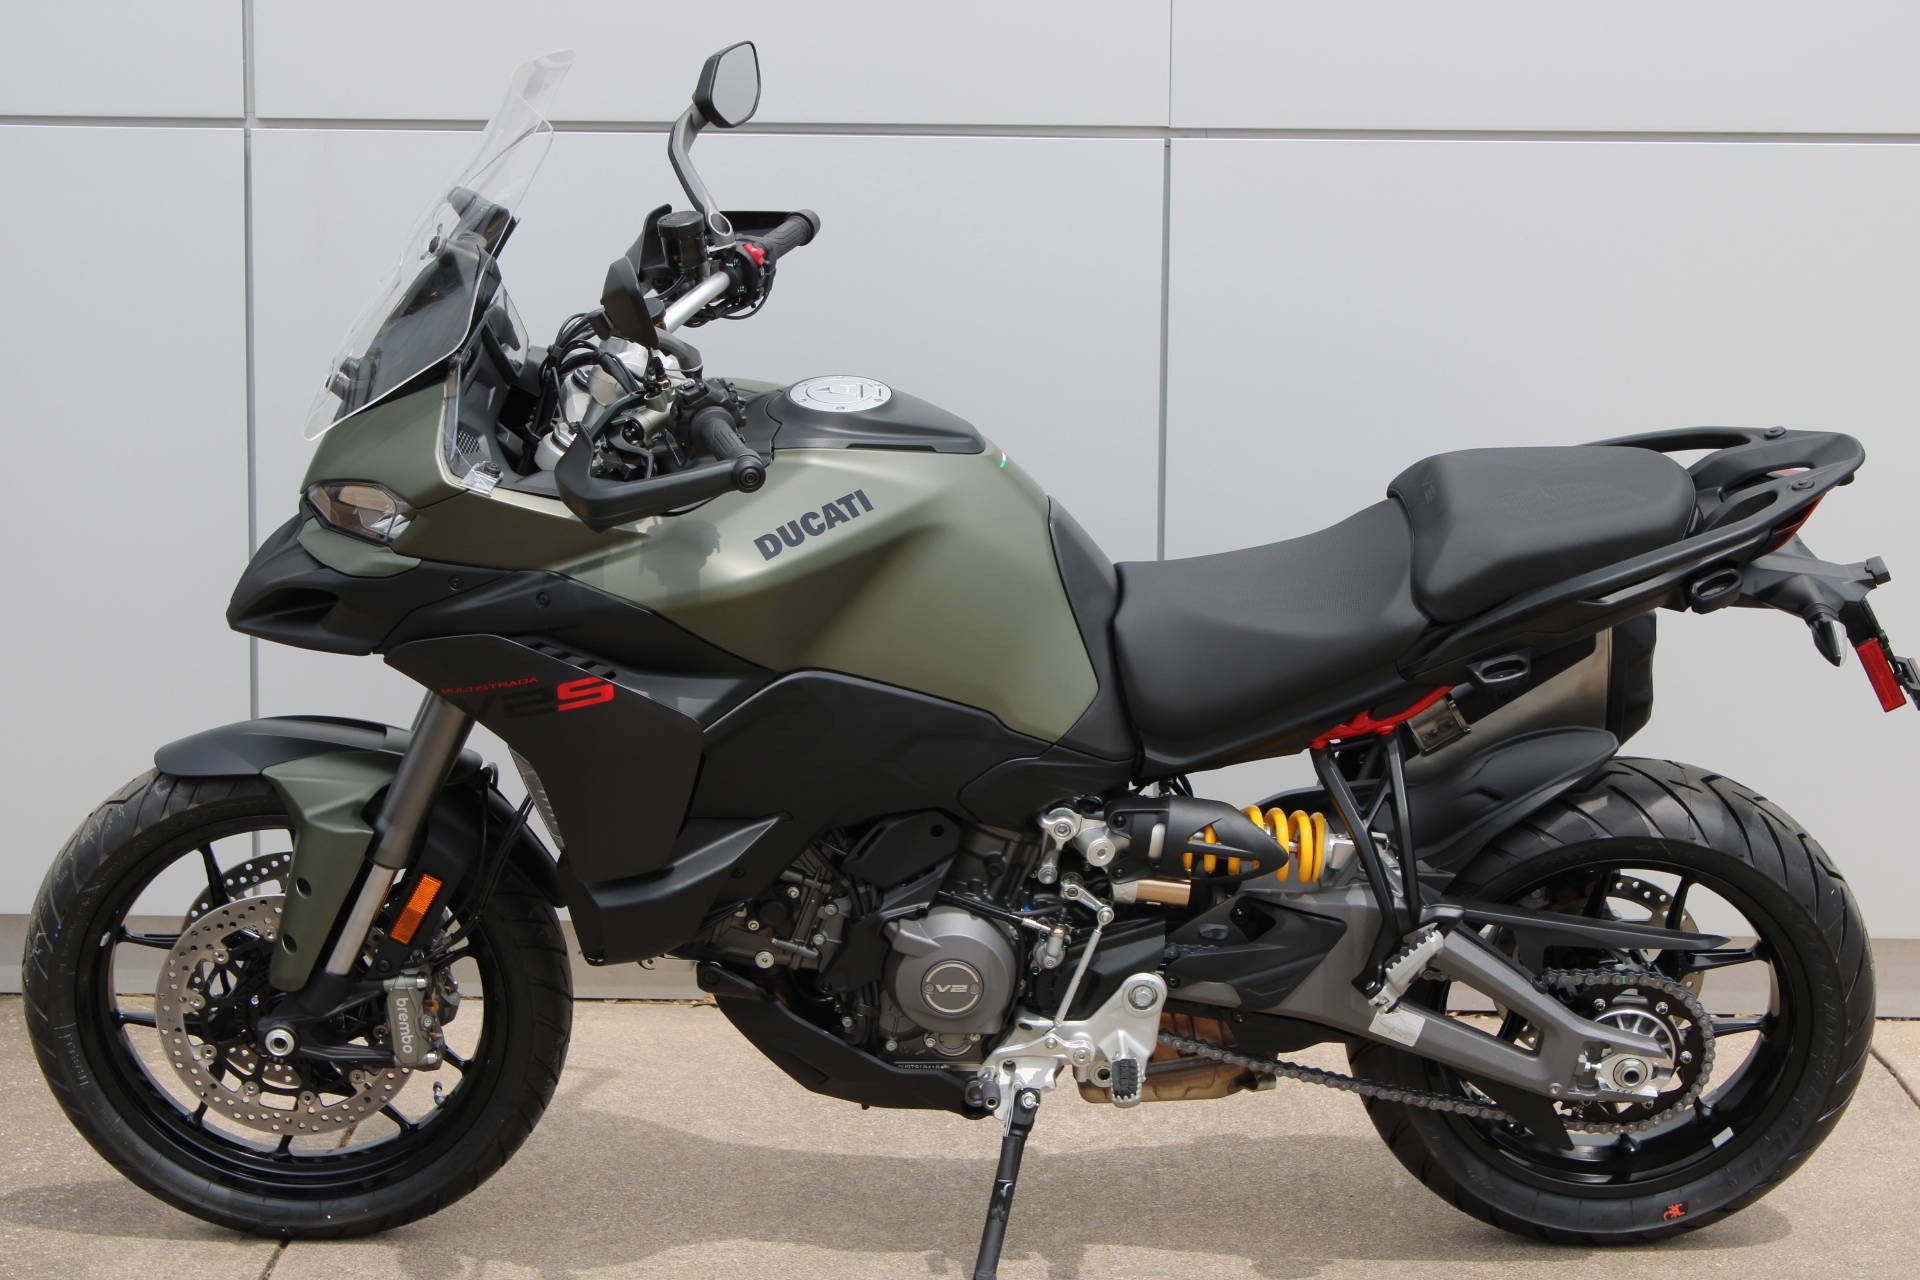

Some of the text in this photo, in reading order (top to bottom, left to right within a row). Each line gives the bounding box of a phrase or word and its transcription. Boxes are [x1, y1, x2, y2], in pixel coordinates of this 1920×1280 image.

[753, 489, 874, 561] DUCATI
[440, 676, 538, 694] MULTISTRADA
[936, 984, 968, 993] V2
[396, 997, 414, 1054] brembo
